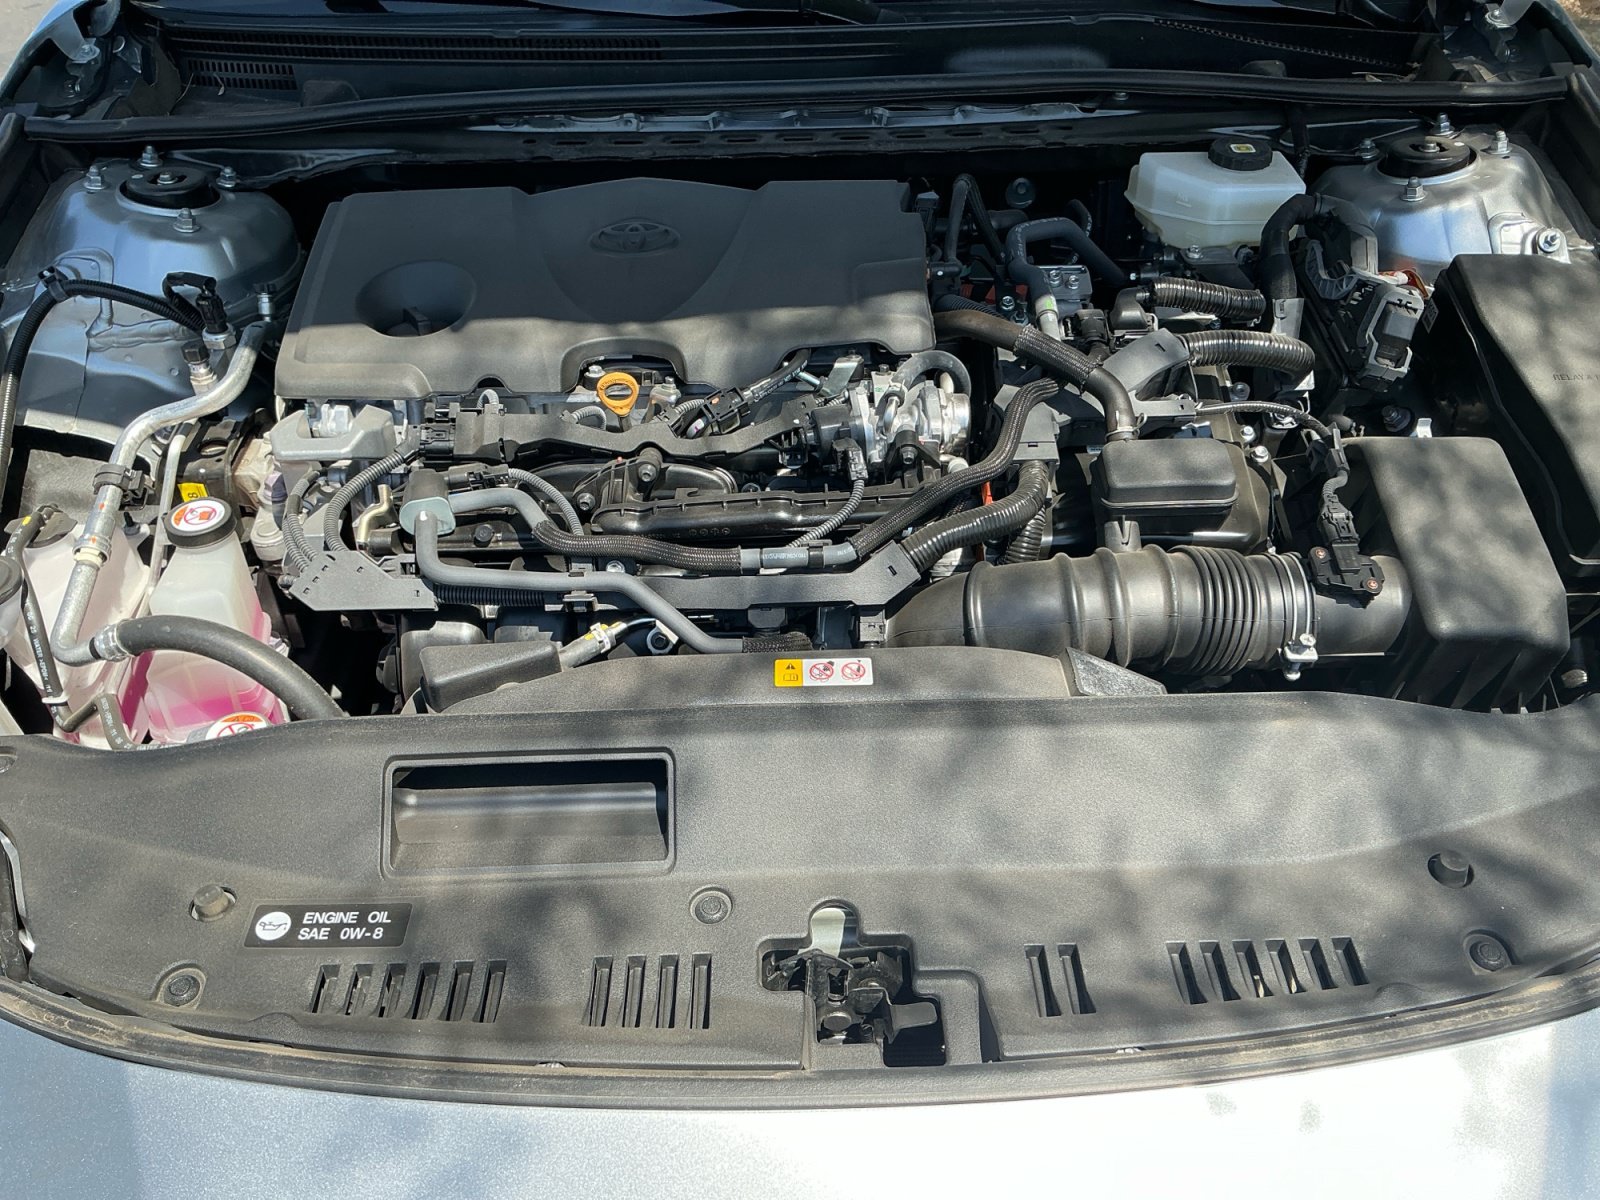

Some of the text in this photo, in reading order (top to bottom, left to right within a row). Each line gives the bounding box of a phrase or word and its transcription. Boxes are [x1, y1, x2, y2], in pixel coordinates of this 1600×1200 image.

[302, 911, 392, 924] ENGINE OIL
[298, 927, 384, 940] SAE 0W-8
